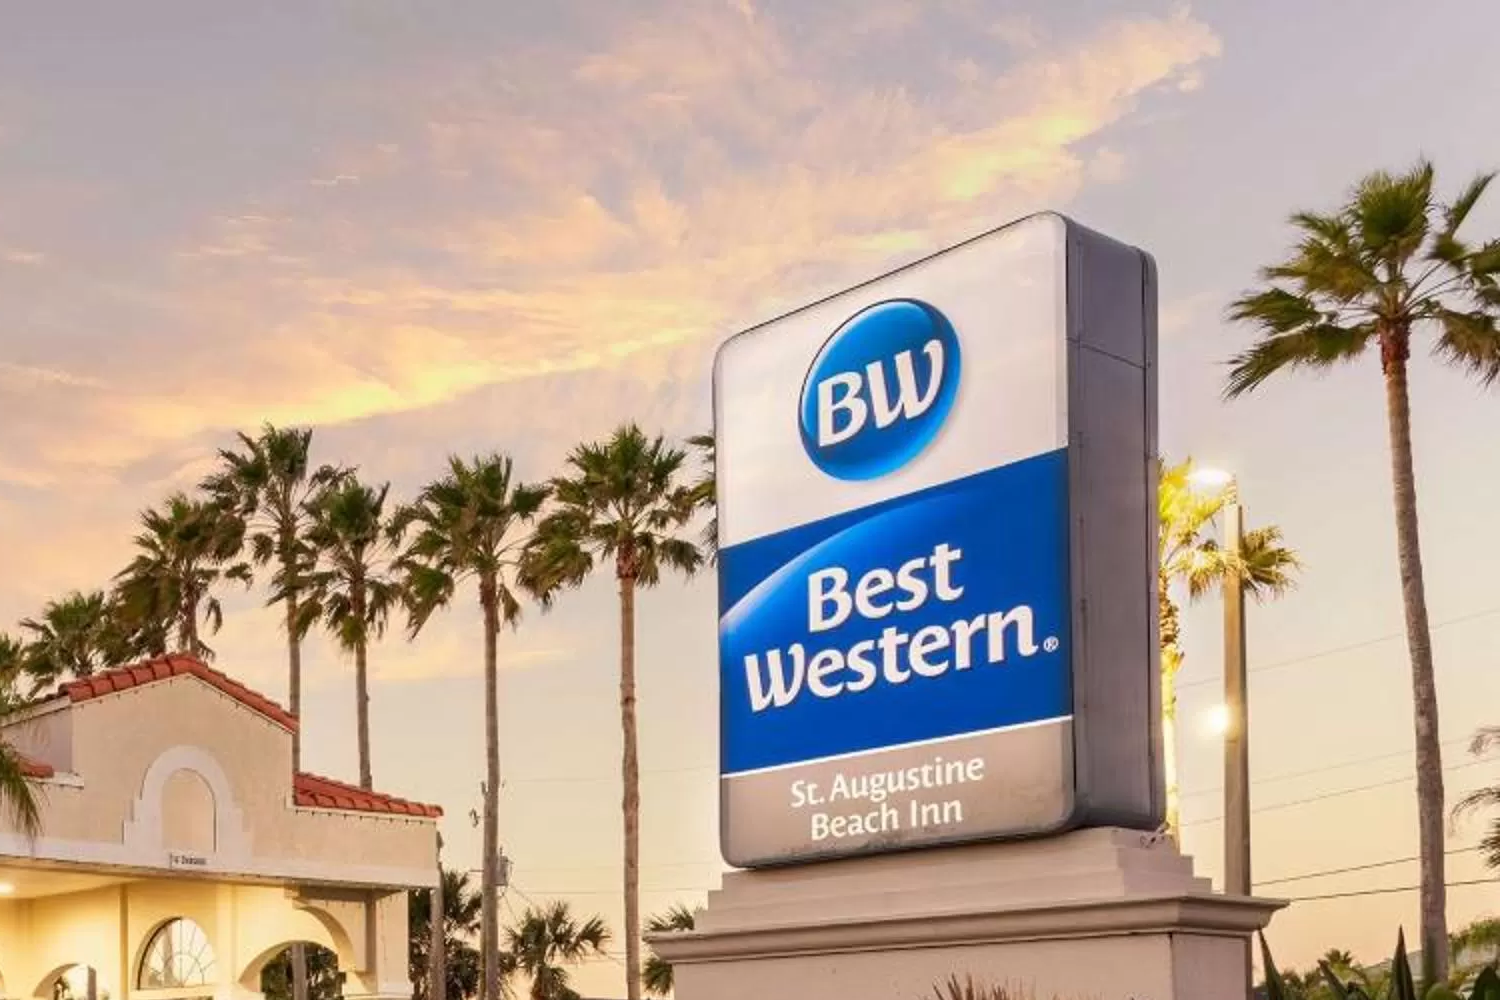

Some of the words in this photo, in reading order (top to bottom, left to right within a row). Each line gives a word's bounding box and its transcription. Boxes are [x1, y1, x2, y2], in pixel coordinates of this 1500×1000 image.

[817, 339, 945, 447] BW
[807, 543, 964, 633] Best
[790, 779, 825, 808] St.
[829, 756, 985, 803] Augustine
[810, 802, 900, 841] Beach
[909, 799, 964, 828] Inn
